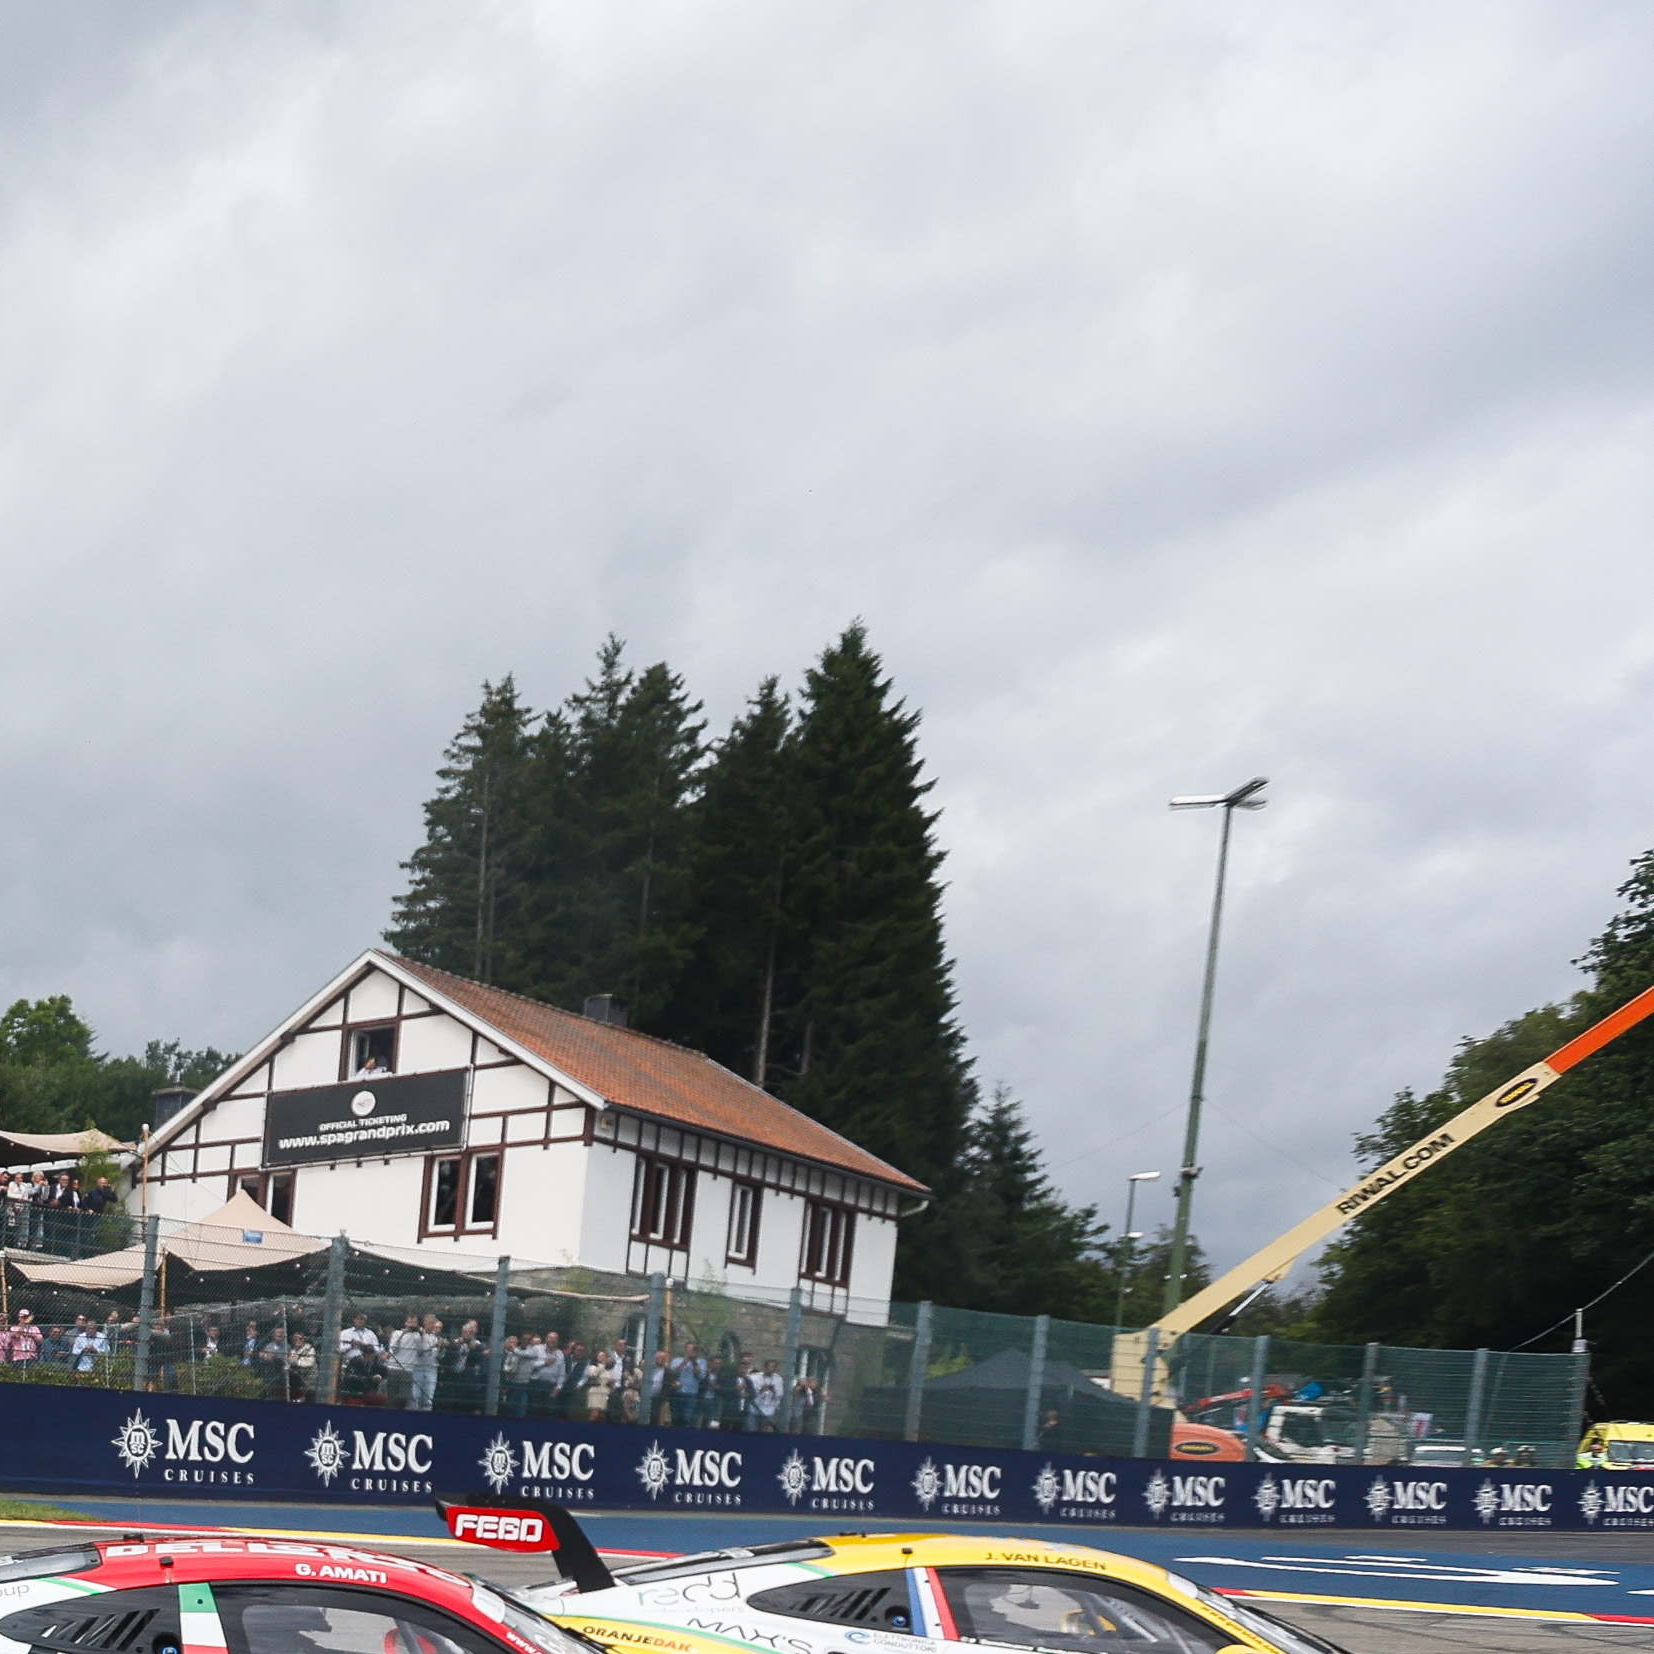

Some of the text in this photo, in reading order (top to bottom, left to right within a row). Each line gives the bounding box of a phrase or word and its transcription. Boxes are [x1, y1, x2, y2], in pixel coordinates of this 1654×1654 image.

[278, 1119, 450, 1149] www.spagrandprix.com
[319, 1113, 408, 1132] OFFICIAL TICKETING
[165, 1419, 254, 1463] MSC
[352, 1431, 432, 1473] MSC
[523, 1441, 594, 1480] MSC
[676, 1449, 741, 1487] MSC
[812, 1457, 874, 1493] MSC
[164, 1469, 253, 1484] CRUISES
[352, 1479, 431, 1492] CRUISES
[944, 1464, 1000, 1499] MSC
[1062, 1470, 1116, 1503] MSC
[1171, 1476, 1225, 1506] MSC
[522, 1486, 593, 1499] CRUISES
[675, 1493, 740, 1504] CRUISES
[1278, 1479, 1335, 1508] MSC
[1390, 1482, 1446, 1509] MSC
[1497, 1484, 1551, 1511] MSC
[1601, 1486, 1654, 1513] MSC
[454, 1513, 544, 1543] FEBO
[295, 1563, 387, 1584] G. AMATI
[1002, 1553, 1040, 1564] VAN
[1043, 1556, 1107, 1571] LAGEN
